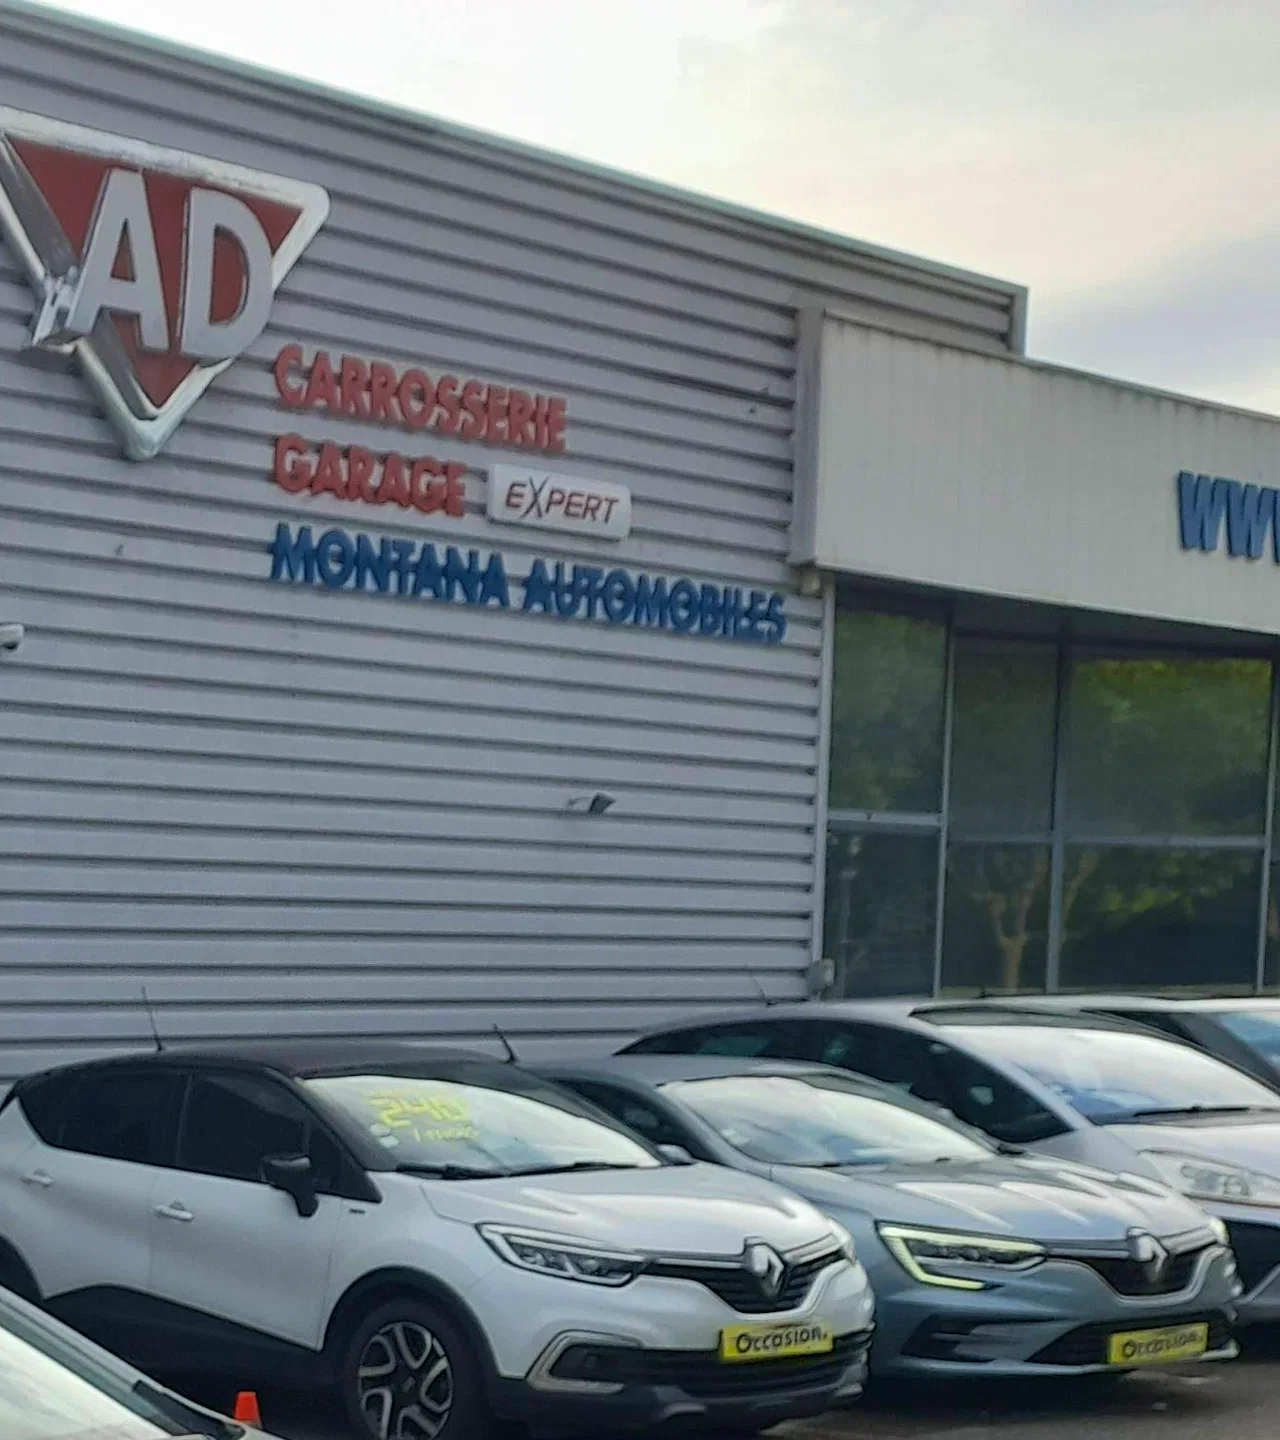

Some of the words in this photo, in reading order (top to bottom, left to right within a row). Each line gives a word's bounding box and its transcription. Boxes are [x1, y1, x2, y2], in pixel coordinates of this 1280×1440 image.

[37, 168, 274, 360] AD
[274, 343, 567, 450] CARROSSERIE
[273, 433, 467, 517] GARAGE
[505, 474, 619, 524] EXPERT
[1178, 469, 1280, 567] WW
[269, 522, 510, 611] MONTANA
[523, 557, 788, 646] AUTOMOBILES
